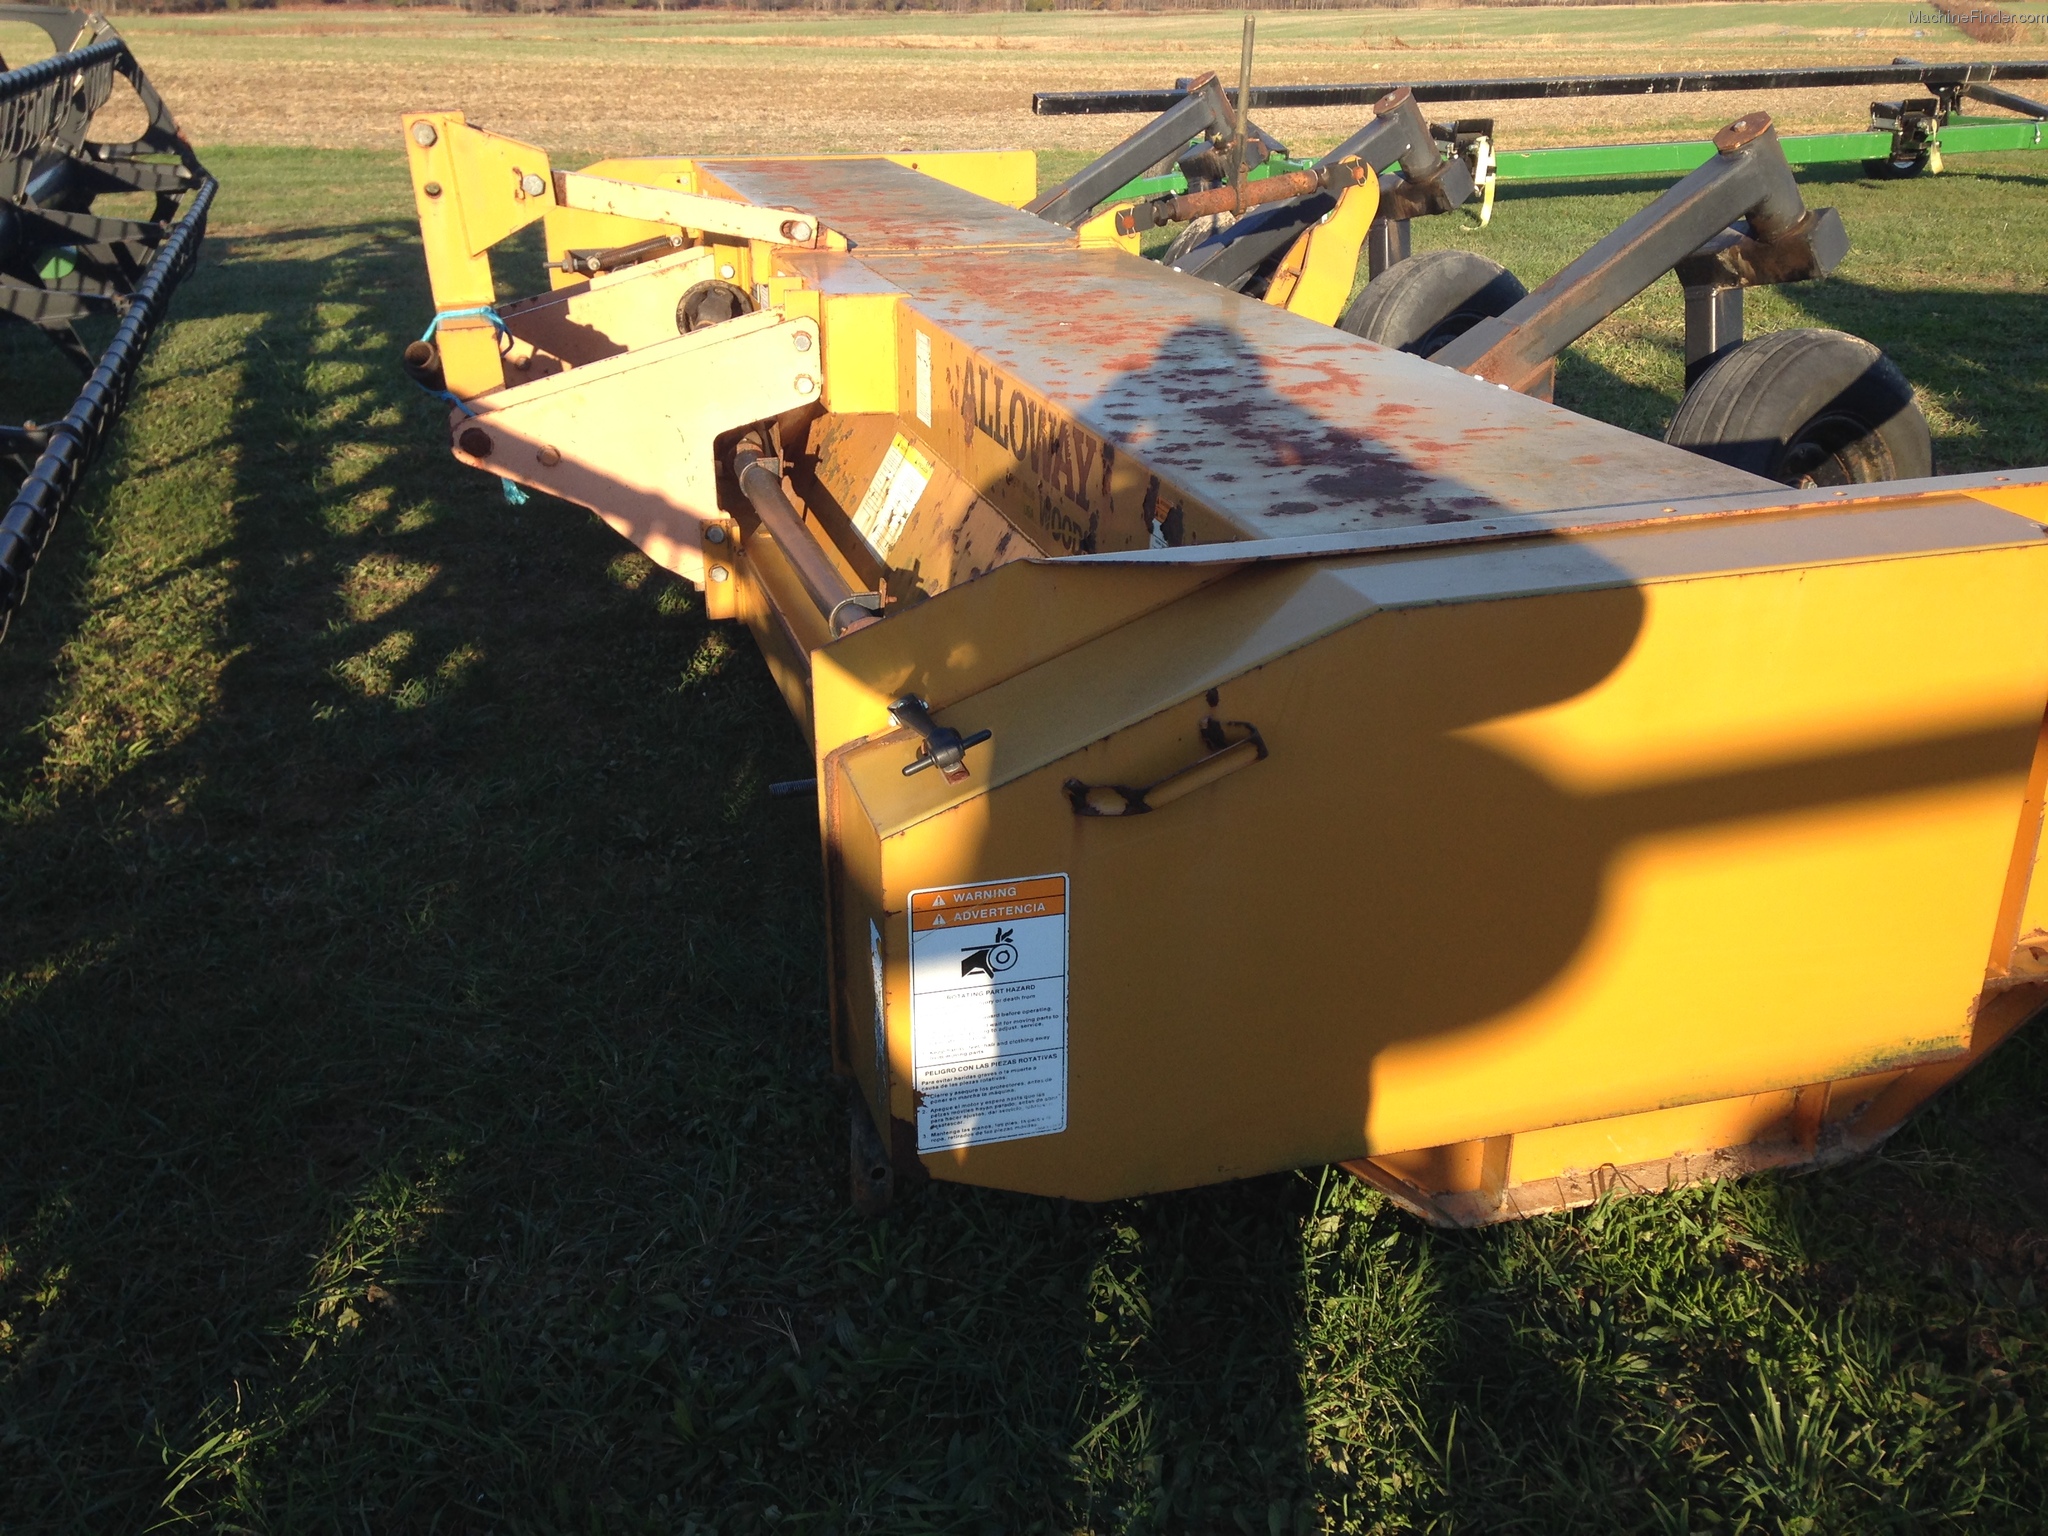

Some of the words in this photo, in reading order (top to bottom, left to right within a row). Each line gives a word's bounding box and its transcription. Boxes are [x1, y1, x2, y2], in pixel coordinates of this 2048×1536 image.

[961, 356, 1097, 512] ALLOWAY
[953, 887, 1017, 903] WARNING
[953, 903, 1046, 922] ADVERTENCIA
[946, 990, 984, 999] ROTATING
[985, 986, 1004, 996] PART
[1005, 984, 1036, 993] HAZARD
[1013, 1017, 1036, 1026] moving
[1036, 1015, 1052, 1023] parts
[1009, 1037, 1034, 1046] clothing
[924, 1067, 957, 1077] PELIGRO
[958, 1064, 974, 1073] CON
[976, 1062, 990, 1071] LAS
[990, 1059, 1017, 1069] PIEZAS
[1018, 1054, 1058, 1064] ROTATIVAS
[953, 1073, 976, 1081] heridas
[977, 1071, 997, 1079] graves
[1010, 1065, 1031, 1073] muerte
[958, 1078, 978, 1086] piezas
[930, 1091, 948, 1099] Cierre
[957, 1092, 980, 1100] marcha
[930, 1105, 953, 1114] Apague
[930, 1128, 960, 1138] Mantenga
[947, 1132, 973, 1140] retirados
[993, 1126, 1013, 1134] piezas
